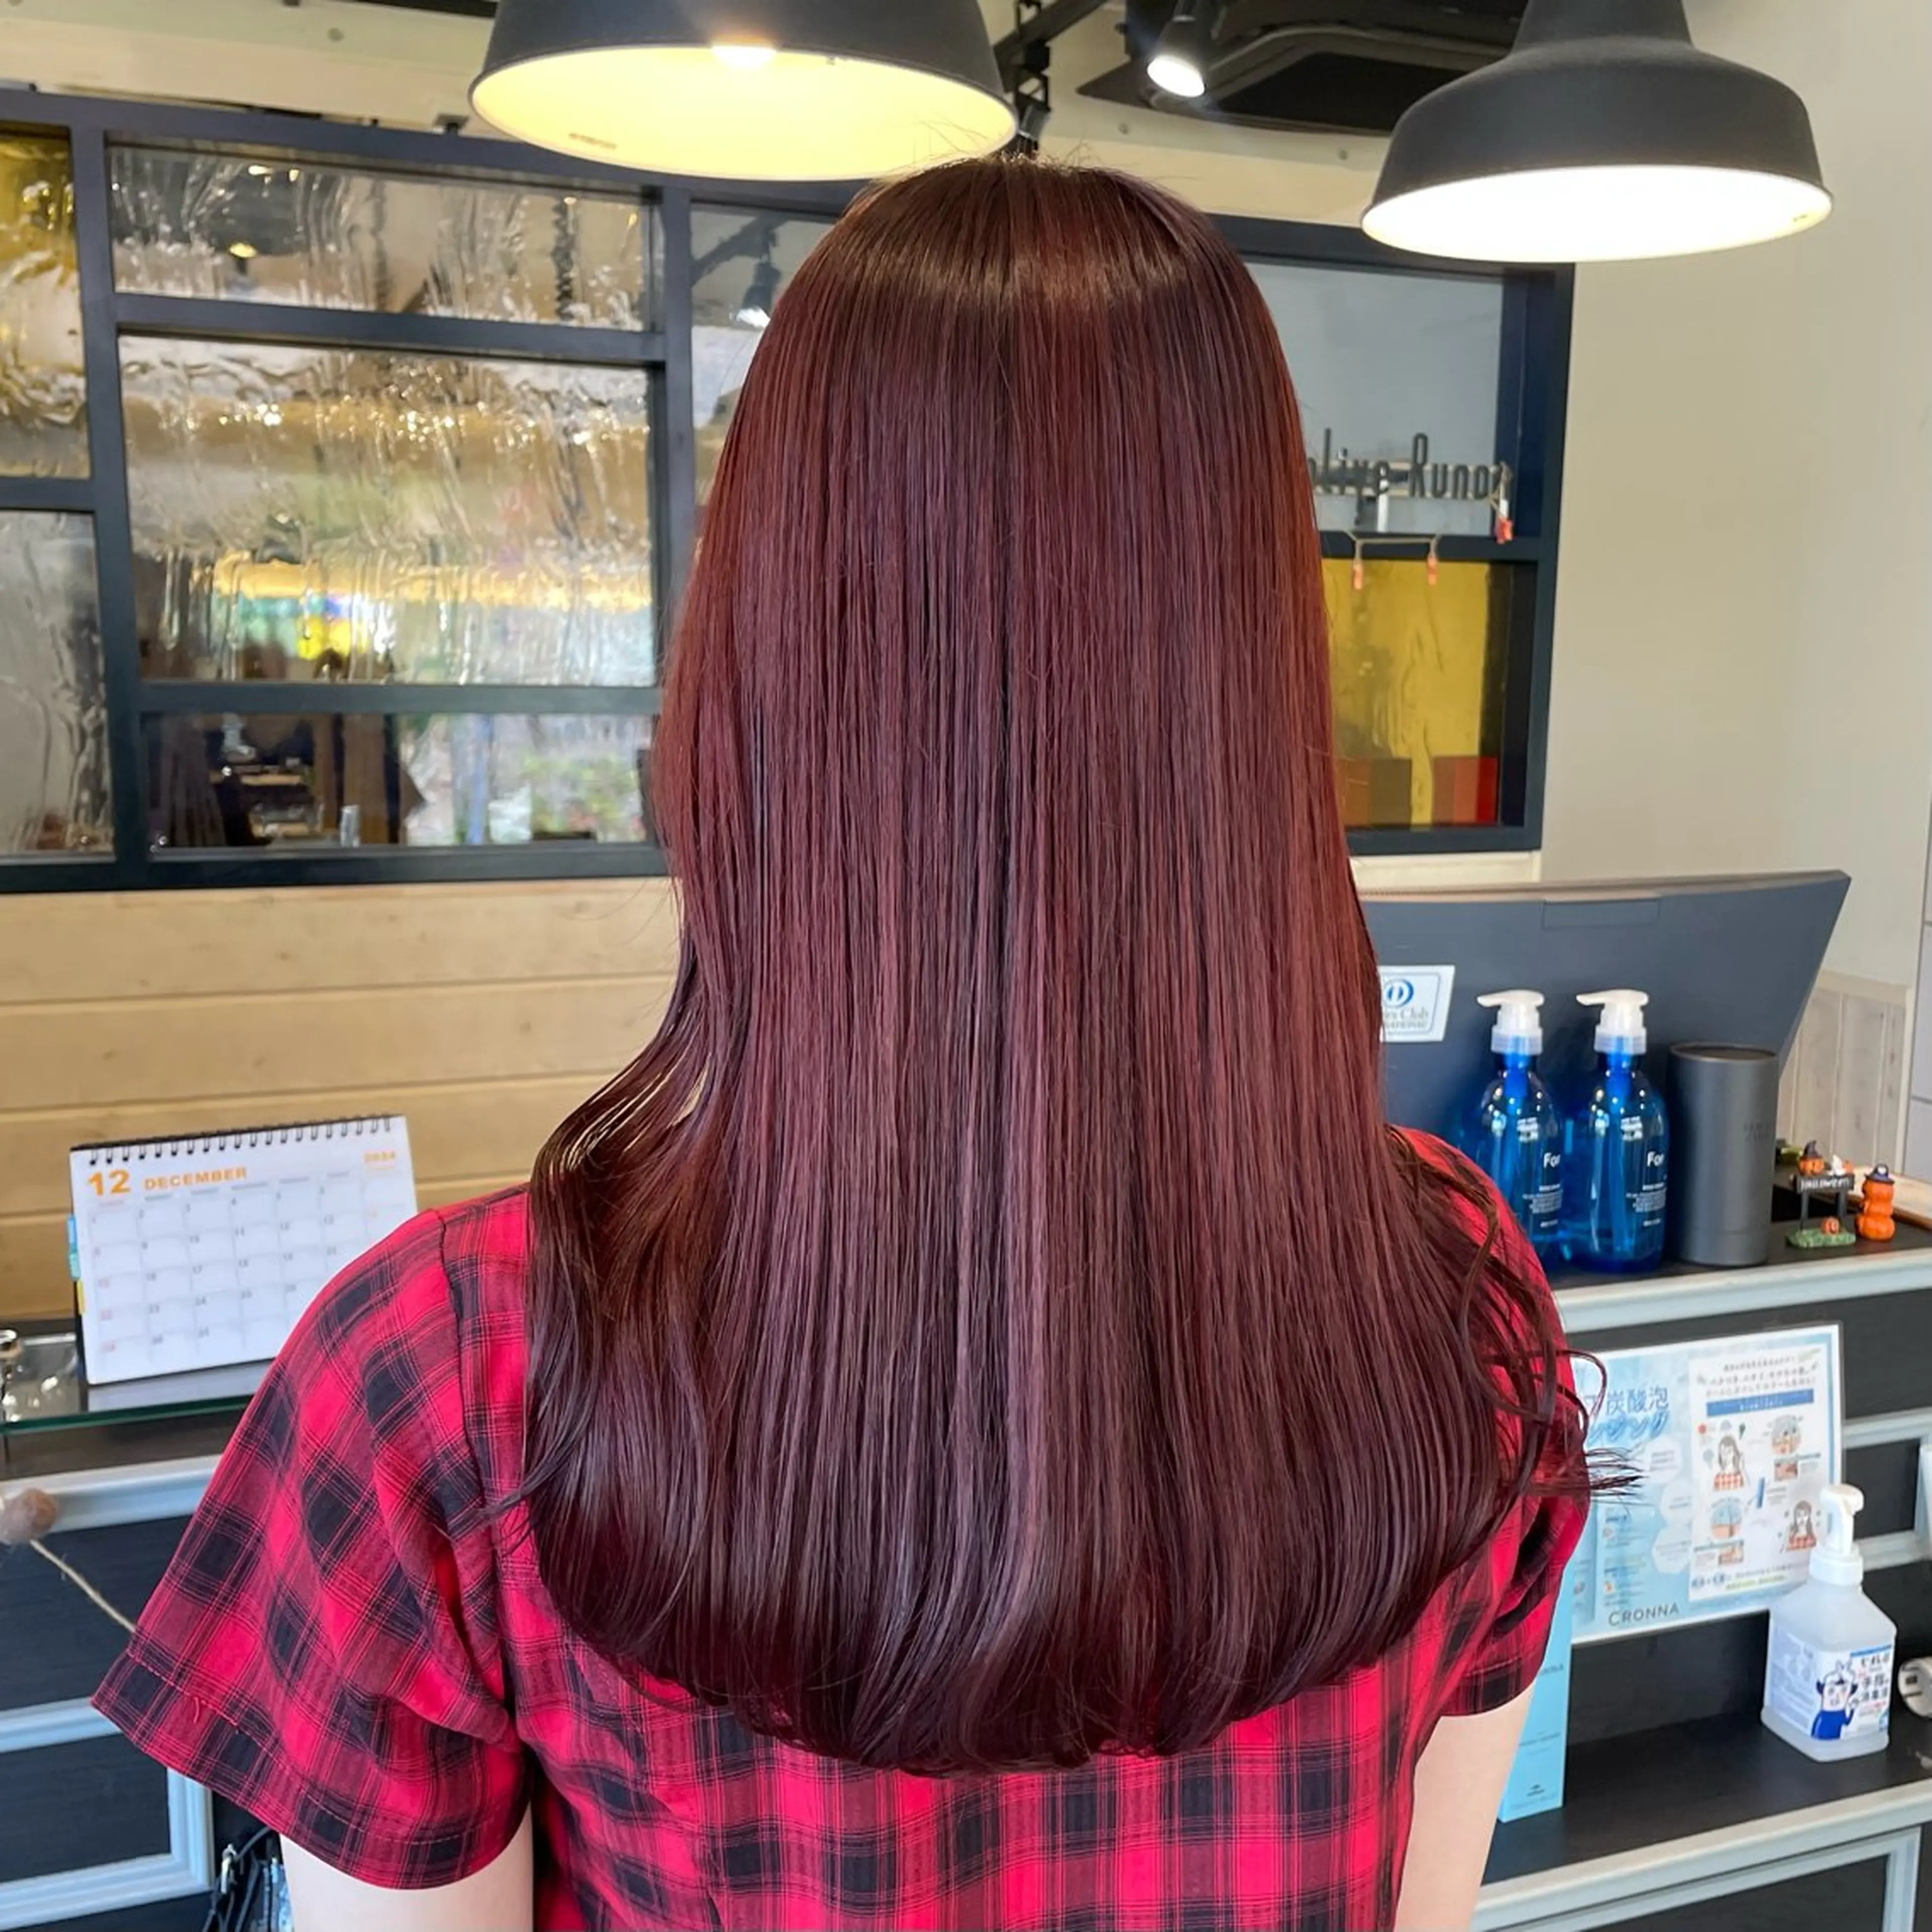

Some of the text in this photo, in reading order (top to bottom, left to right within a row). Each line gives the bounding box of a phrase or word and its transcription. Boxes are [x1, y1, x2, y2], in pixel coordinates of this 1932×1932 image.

[88, 1166, 247, 1196] 12 DECEMBER
[1608, 1602, 1680, 1627] CRONNA
